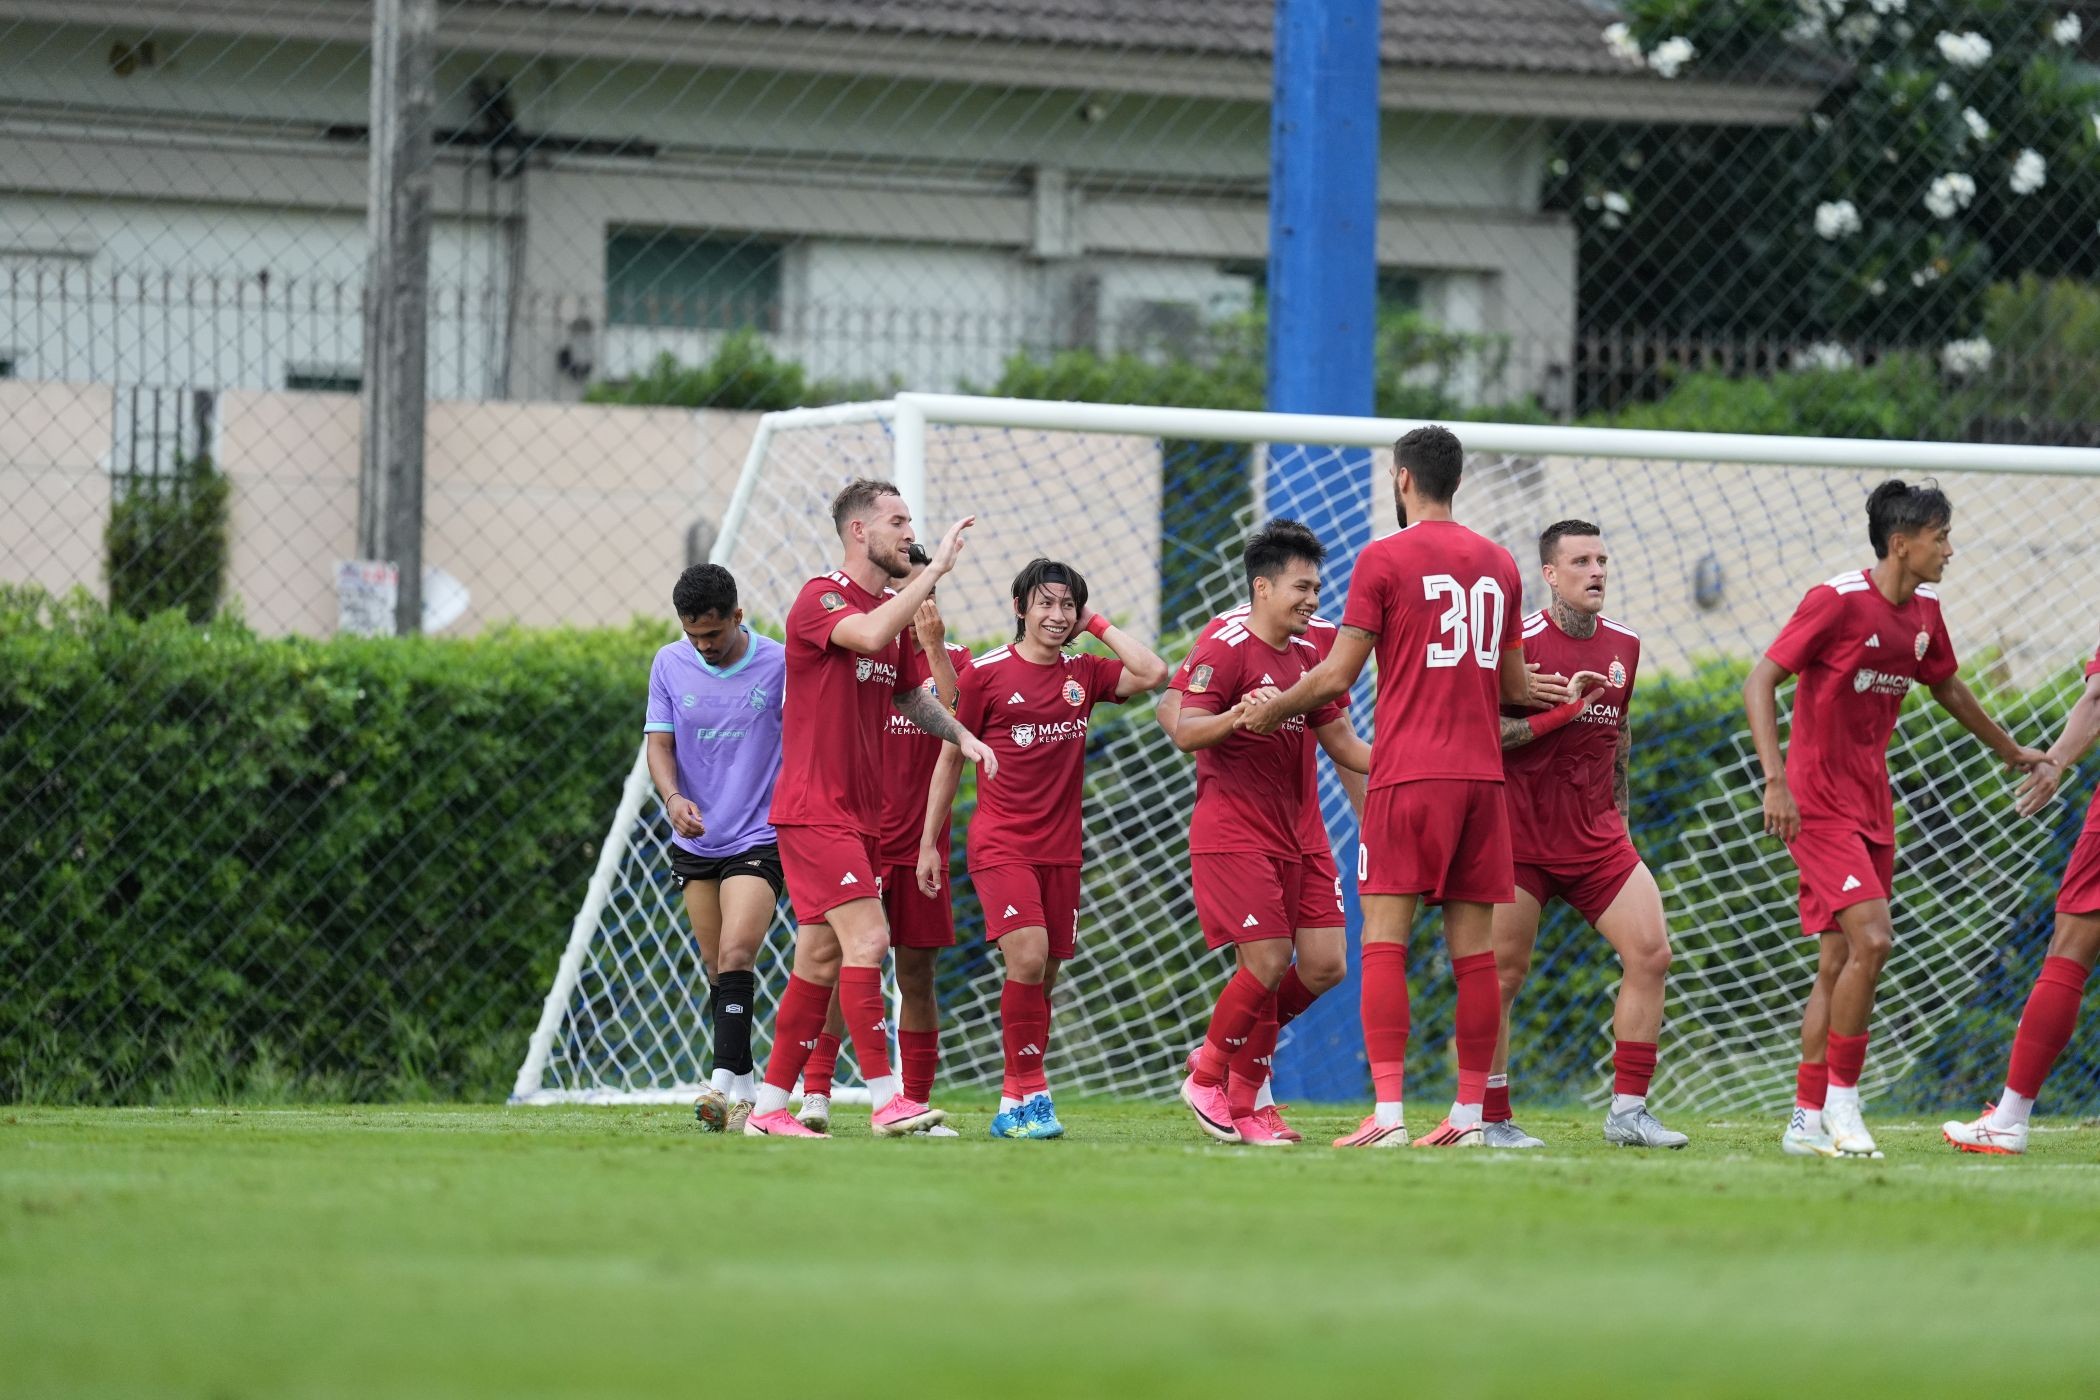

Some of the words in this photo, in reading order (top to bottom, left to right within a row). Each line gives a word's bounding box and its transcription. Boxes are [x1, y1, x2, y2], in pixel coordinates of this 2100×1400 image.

[1422, 574, 1505, 671] 30
[1585, 703, 1620, 719] ACAN
[1575, 715, 1618, 726] MAYORAN
[890, 727, 928, 735] KEMAY
